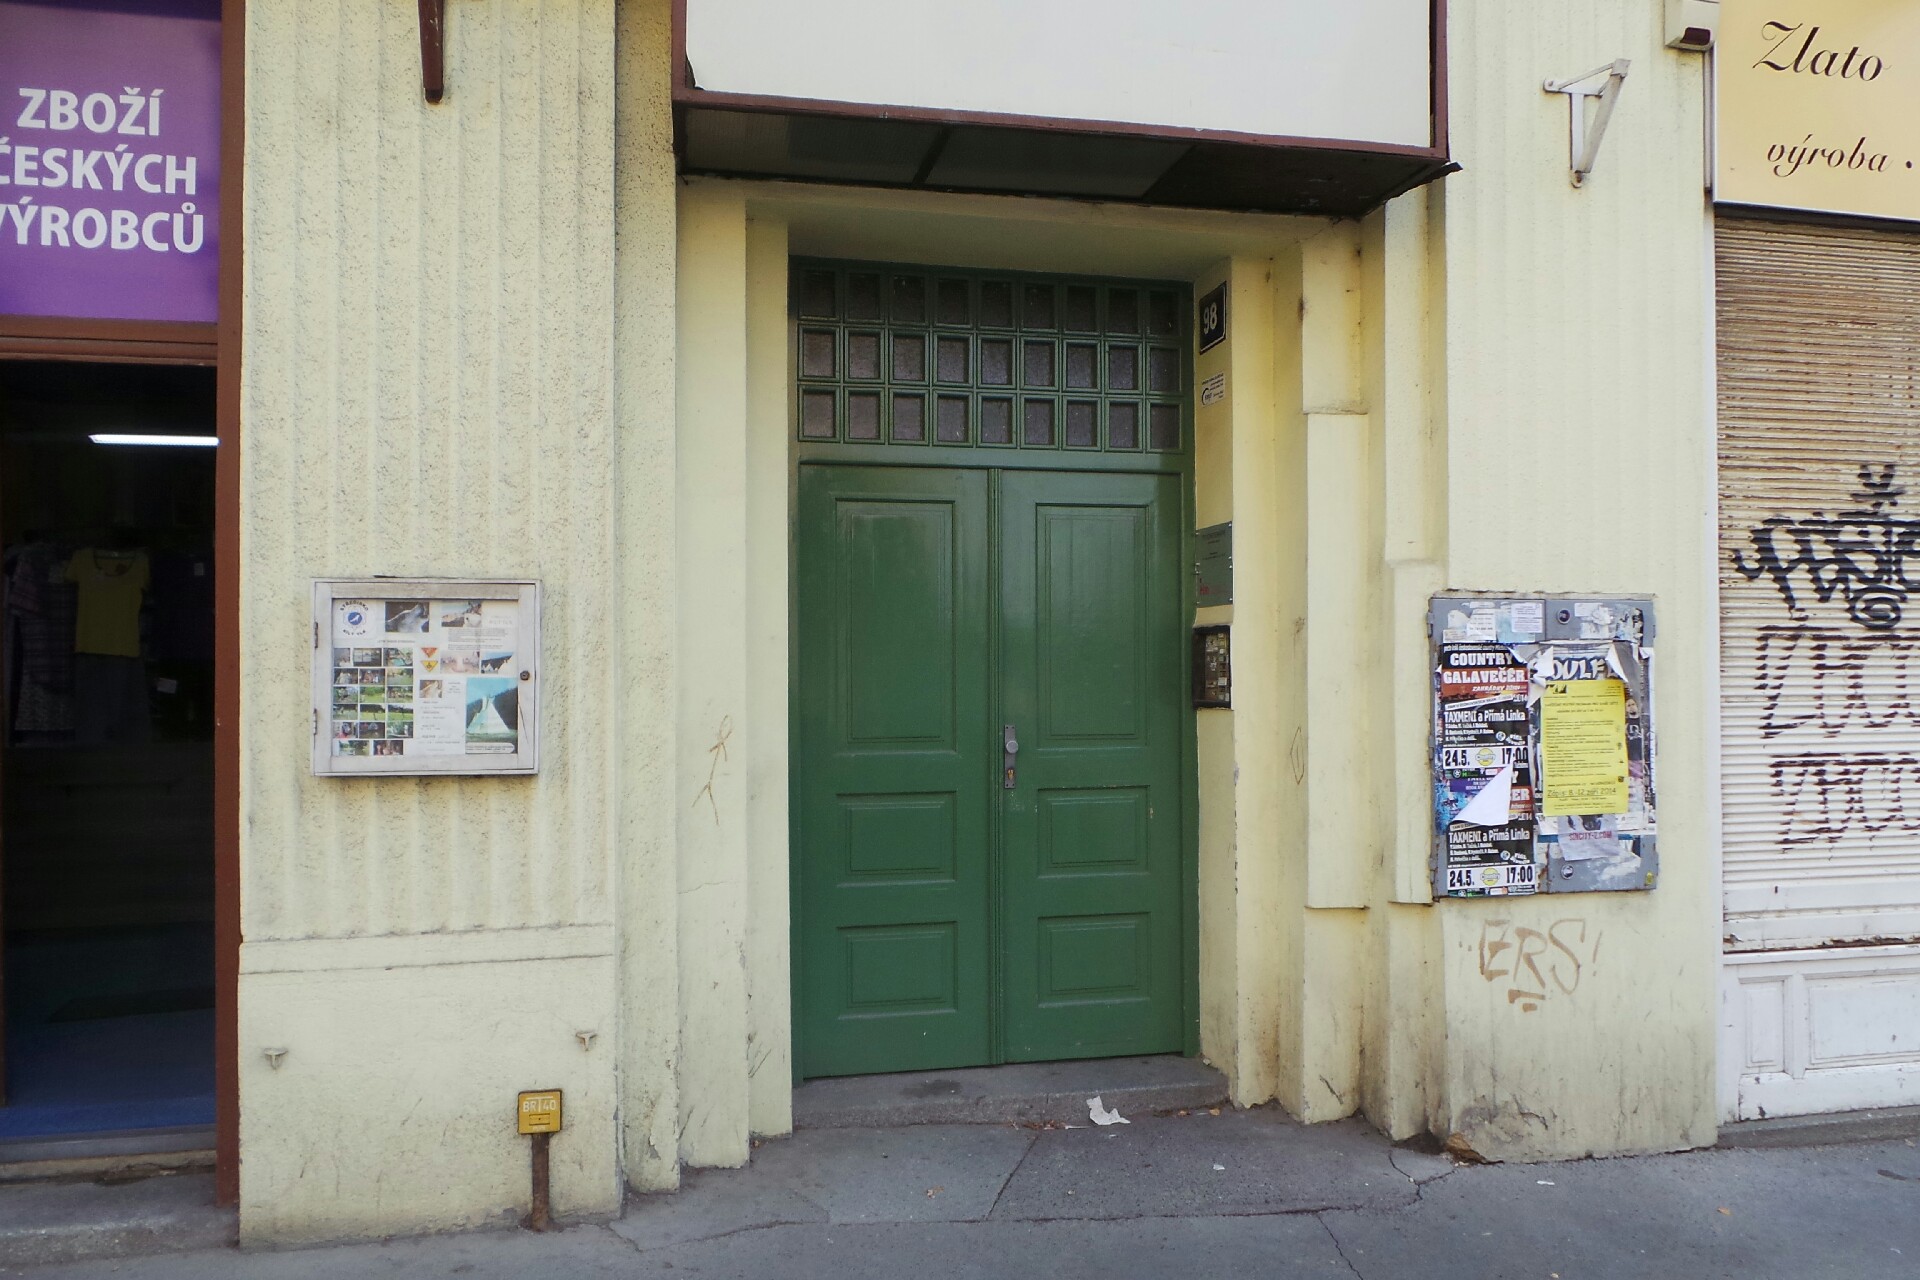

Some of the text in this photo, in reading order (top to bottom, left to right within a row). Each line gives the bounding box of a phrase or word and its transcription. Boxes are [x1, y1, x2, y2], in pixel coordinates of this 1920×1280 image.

[1752, 20, 1892, 82] Zlato
[17, 86, 164, 136] ZBOŽÍ
[1767, 133, 1893, 178] výroba
[1203, 301, 1217, 335] 98
[1450, 653, 1513, 666] COUNTRY
[1444, 709, 1526, 722] TAXMENI a Přímá Linka
[1445, 749, 1470, 767] 24.5.
[1449, 828, 1530, 843] TAXMENI a Přímá Linka
[1450, 869, 1475, 887] 24.5.
[1506, 866, 1533, 883] 17:00
